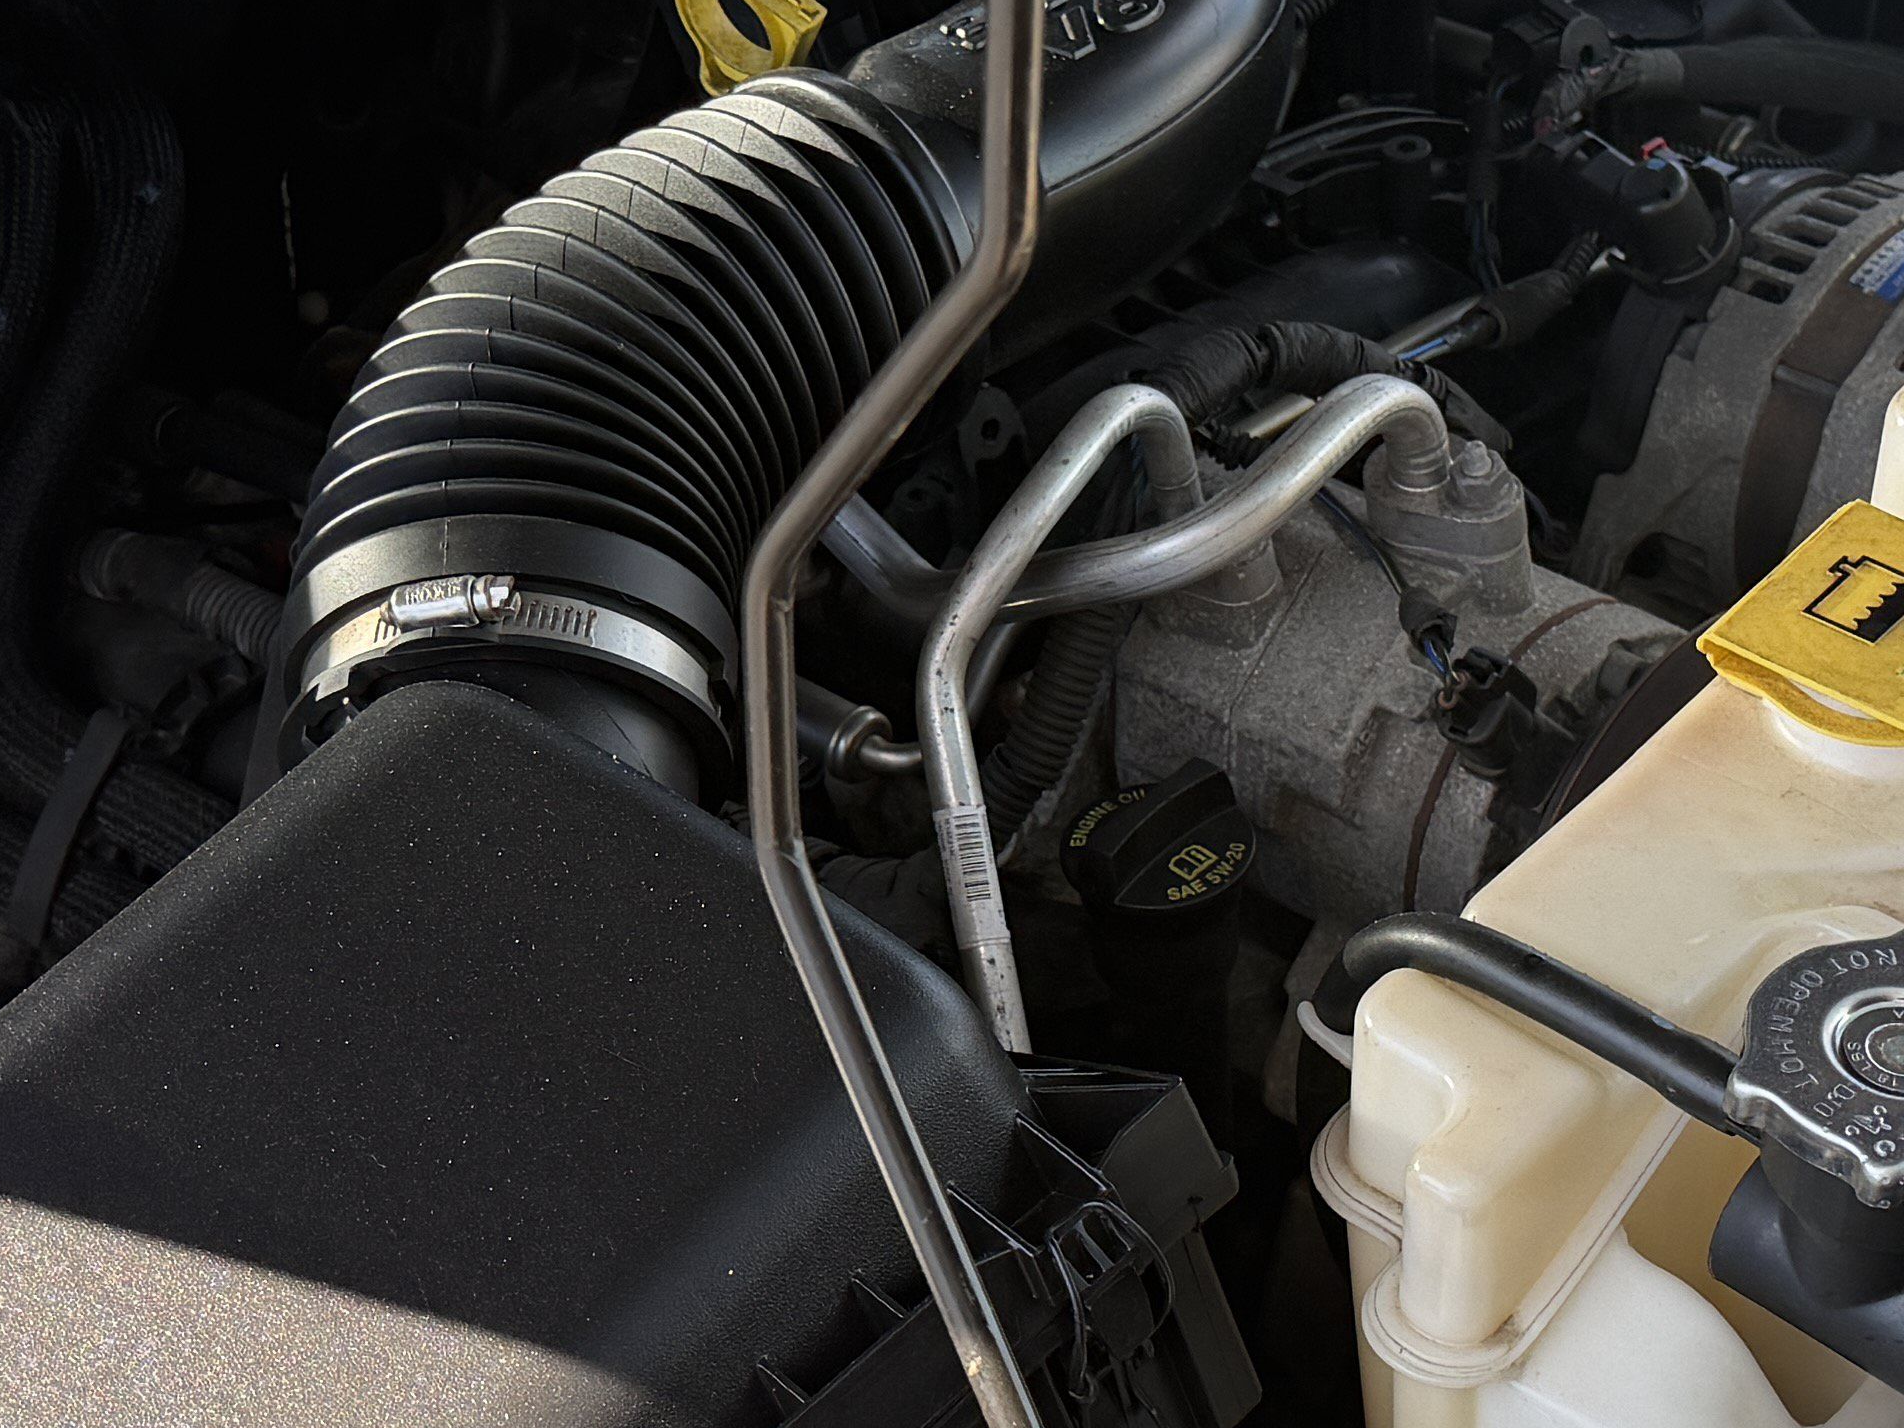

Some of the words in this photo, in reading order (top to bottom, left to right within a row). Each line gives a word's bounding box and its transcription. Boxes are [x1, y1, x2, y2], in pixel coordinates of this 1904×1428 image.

[1069, 801, 1118, 847] ENGINE
[1167, 879, 1207, 901] SAE
[1206, 843, 1246, 884] 5W-20
[1831, 948, 1897, 977] NOT
[1771, 969, 1823, 1033] OPEN
